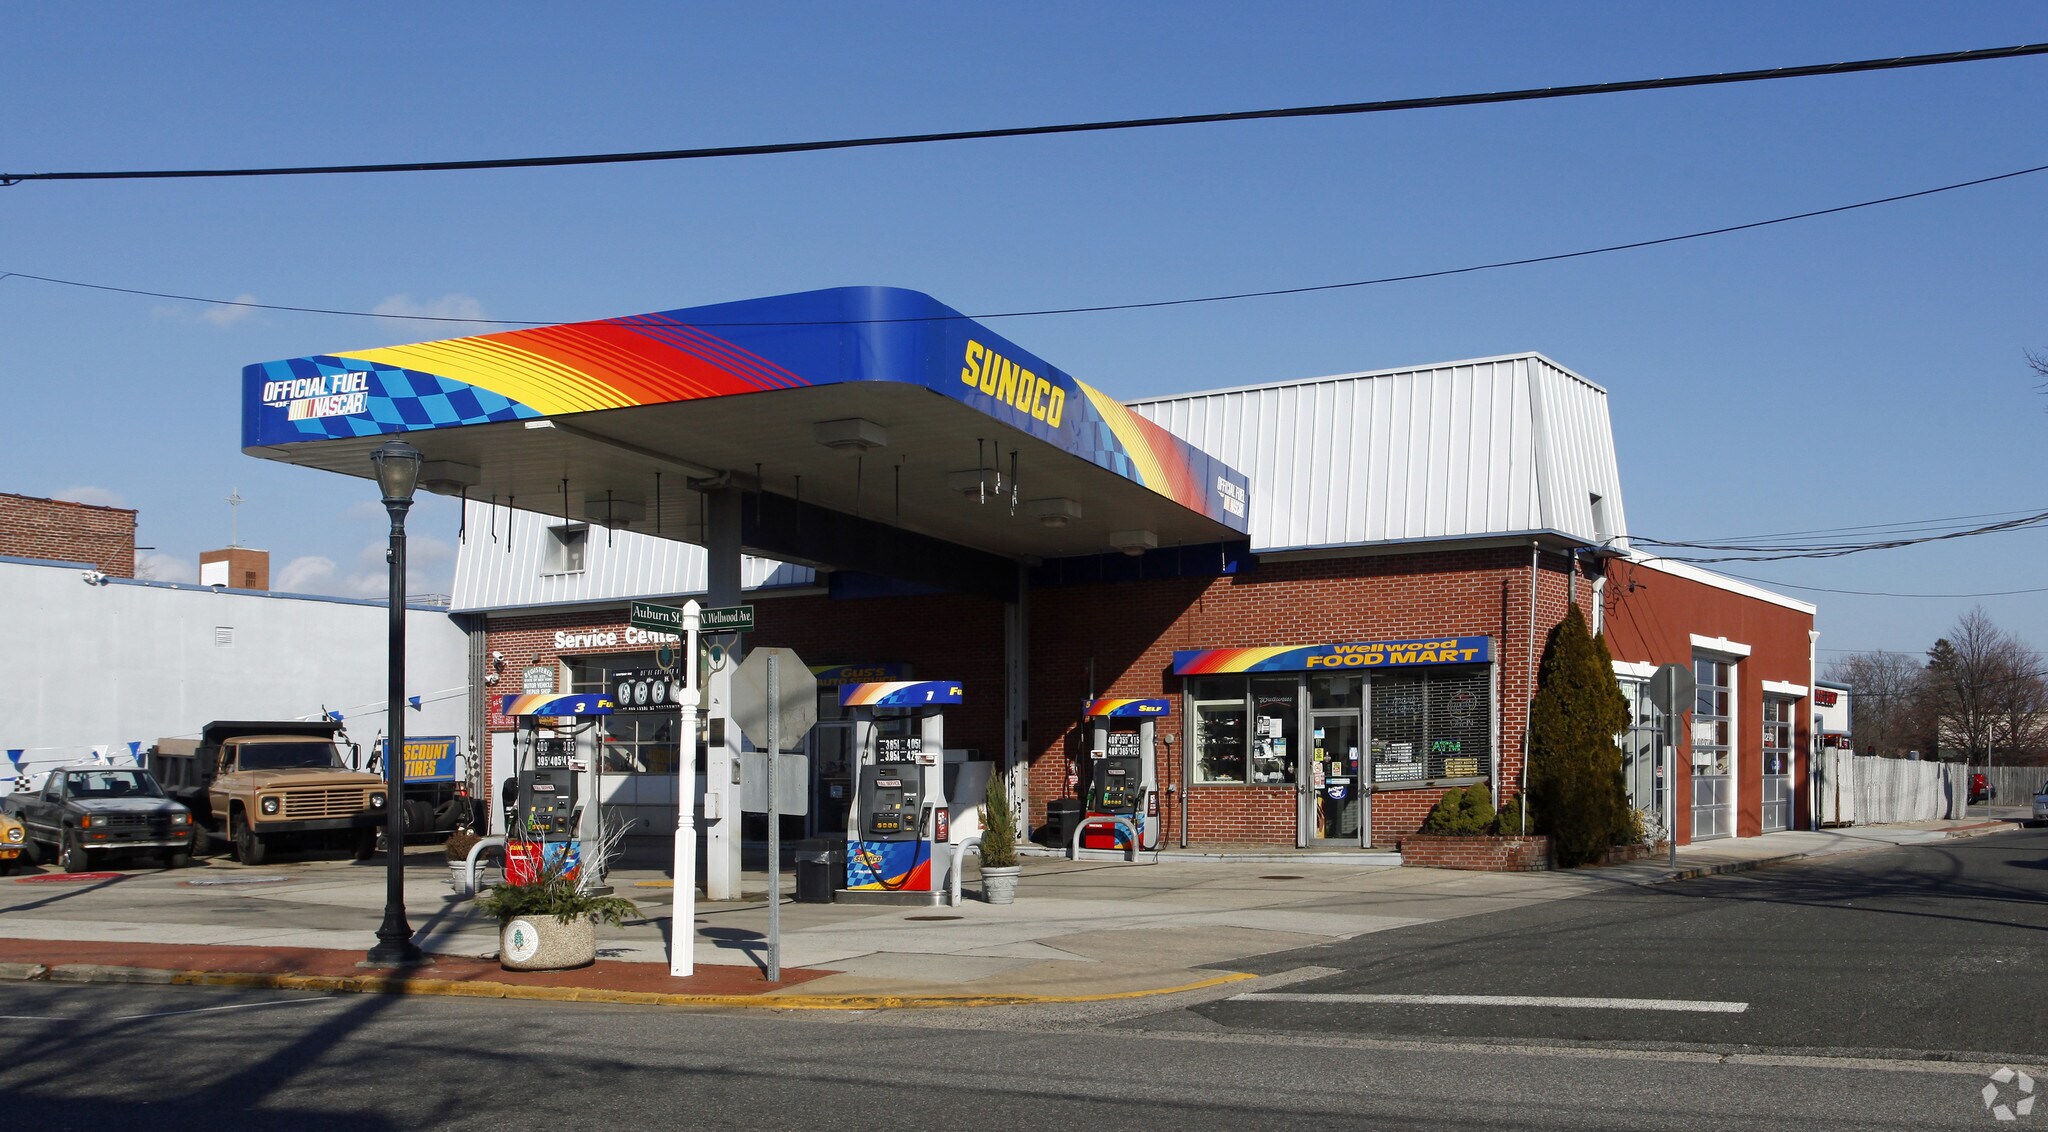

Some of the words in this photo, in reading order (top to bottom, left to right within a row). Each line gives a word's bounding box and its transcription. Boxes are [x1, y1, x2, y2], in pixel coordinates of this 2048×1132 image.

[263, 376, 328, 402] OFFICIAL
[330, 371, 369, 394] FUEL
[961, 339, 1065, 428] SUNOCO
[313, 394, 365, 417] NASCAR
[632, 606, 669, 621] Auburn
[671, 611, 683, 623] St.
[701, 614, 708, 624] N.
[708, 609, 738, 624] Wellwood
[739, 610, 752, 622] Ave.
[554, 629, 617, 649] Service
[1334, 640, 1458, 654] Wellwood
[1306, 654, 1384, 668] FOOD
[1389, 649, 1479, 664] MART
[524, 667, 553, 679] REGISTERED
[926, 691, 934, 701] 1
[949, 687, 962, 695] FU
[574, 703, 585, 712] 3
[404, 743, 448, 760] SCOUNT
[1432, 741, 1460, 752] ATM
[405, 760, 436, 777] TIRES
